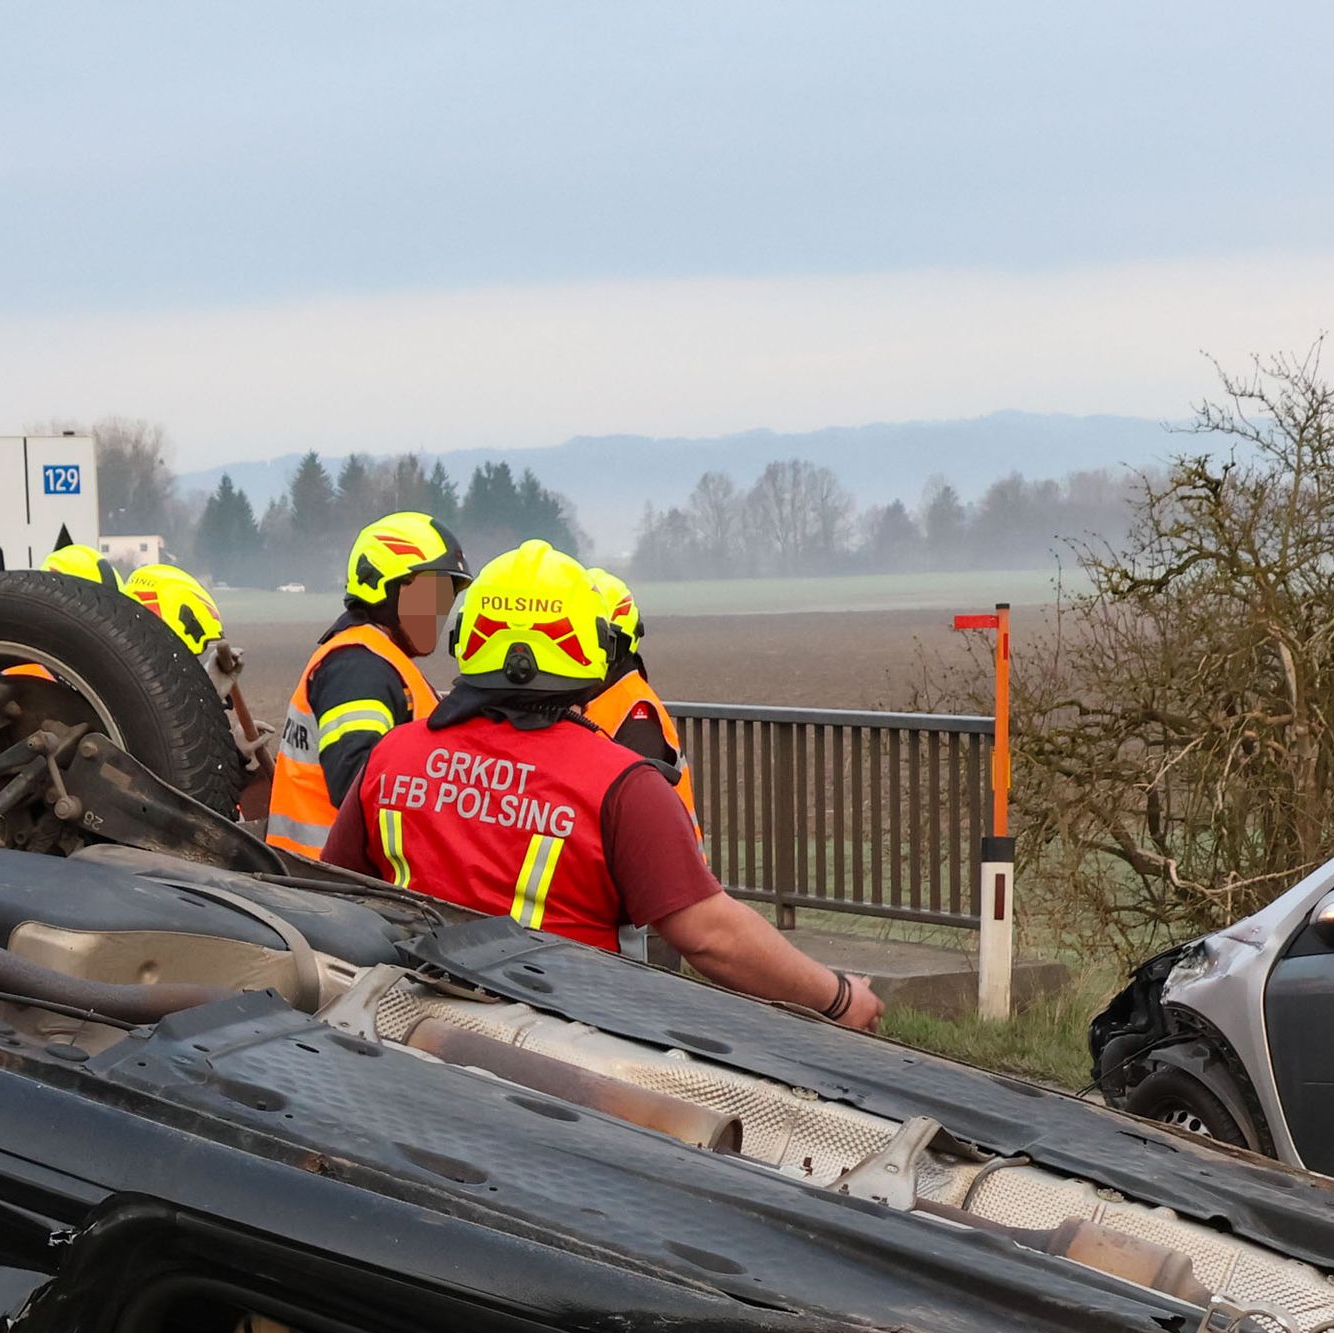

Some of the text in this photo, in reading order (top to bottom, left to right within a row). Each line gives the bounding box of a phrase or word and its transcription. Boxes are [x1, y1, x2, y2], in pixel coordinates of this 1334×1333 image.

[45, 468, 79, 492] 129
[481, 596, 564, 613] POLSING
[425, 747, 536, 795] GRKDT
[378, 774, 576, 837] LFB POLSING
